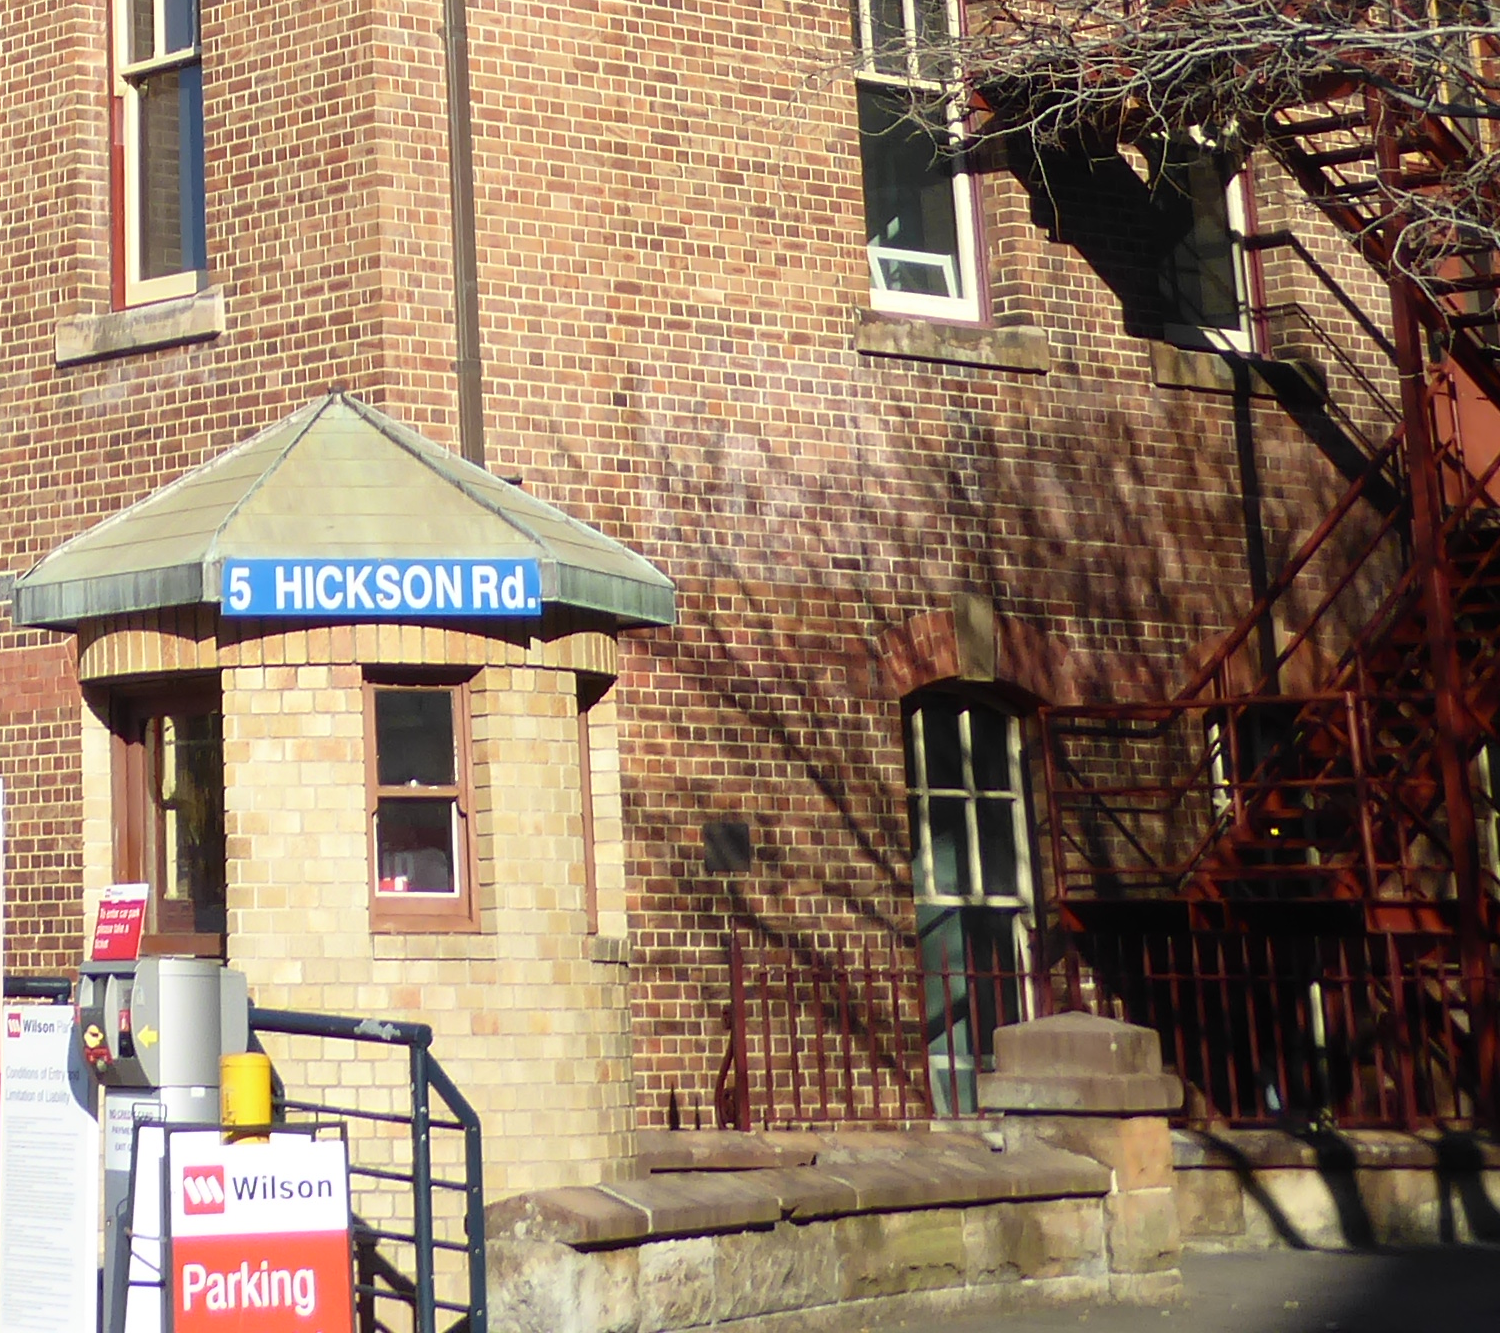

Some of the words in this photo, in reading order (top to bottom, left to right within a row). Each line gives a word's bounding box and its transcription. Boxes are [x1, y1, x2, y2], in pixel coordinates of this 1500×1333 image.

[229, 567, 251, 611] 5
[275, 565, 463, 610] HICKSON
[471, 565, 537, 609] Rd.
[23, 1019, 55, 1033] Wilson
[5, 1066, 39, 1079] Conditions
[48, 1067, 65, 1082] Entry
[5, 1089, 36, 1102] Limitation
[45, 1090, 71, 1105] Liability
[232, 1175, 333, 1201] Wilson
[182, 1260, 315, 1316] Parking
